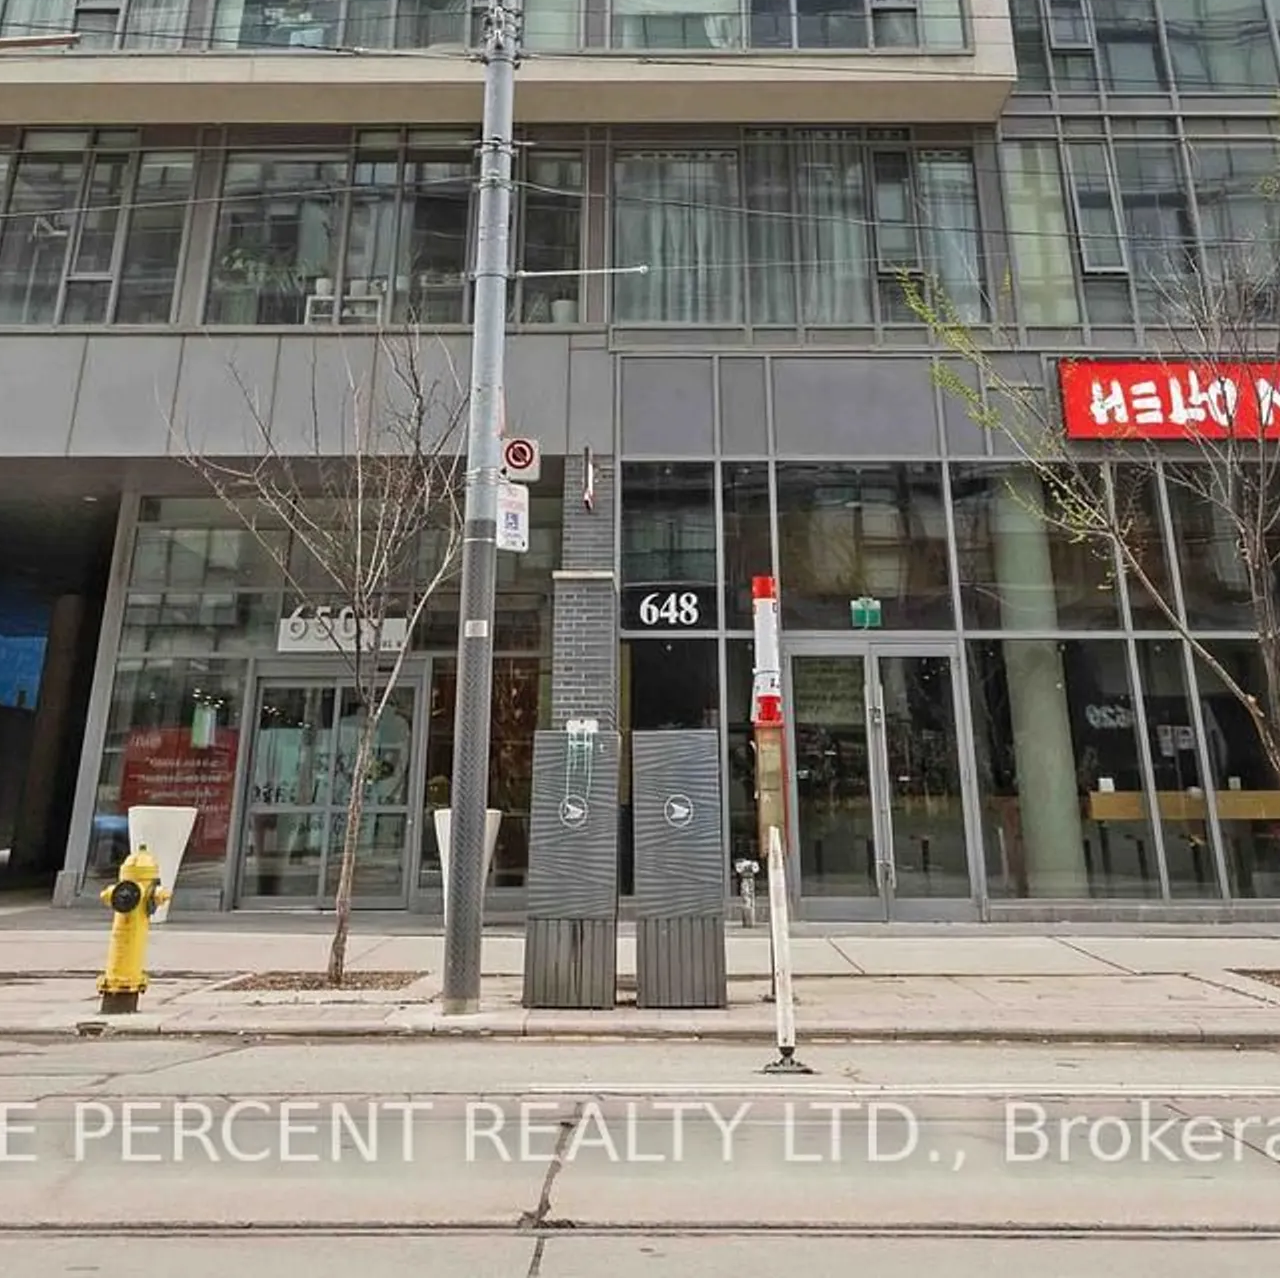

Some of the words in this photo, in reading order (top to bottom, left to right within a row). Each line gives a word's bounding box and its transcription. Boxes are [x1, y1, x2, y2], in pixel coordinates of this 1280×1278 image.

[1089, 369, 1238, 427] HELLO
[288, 603, 358, 641] 650
[639, 592, 699, 625] 648
